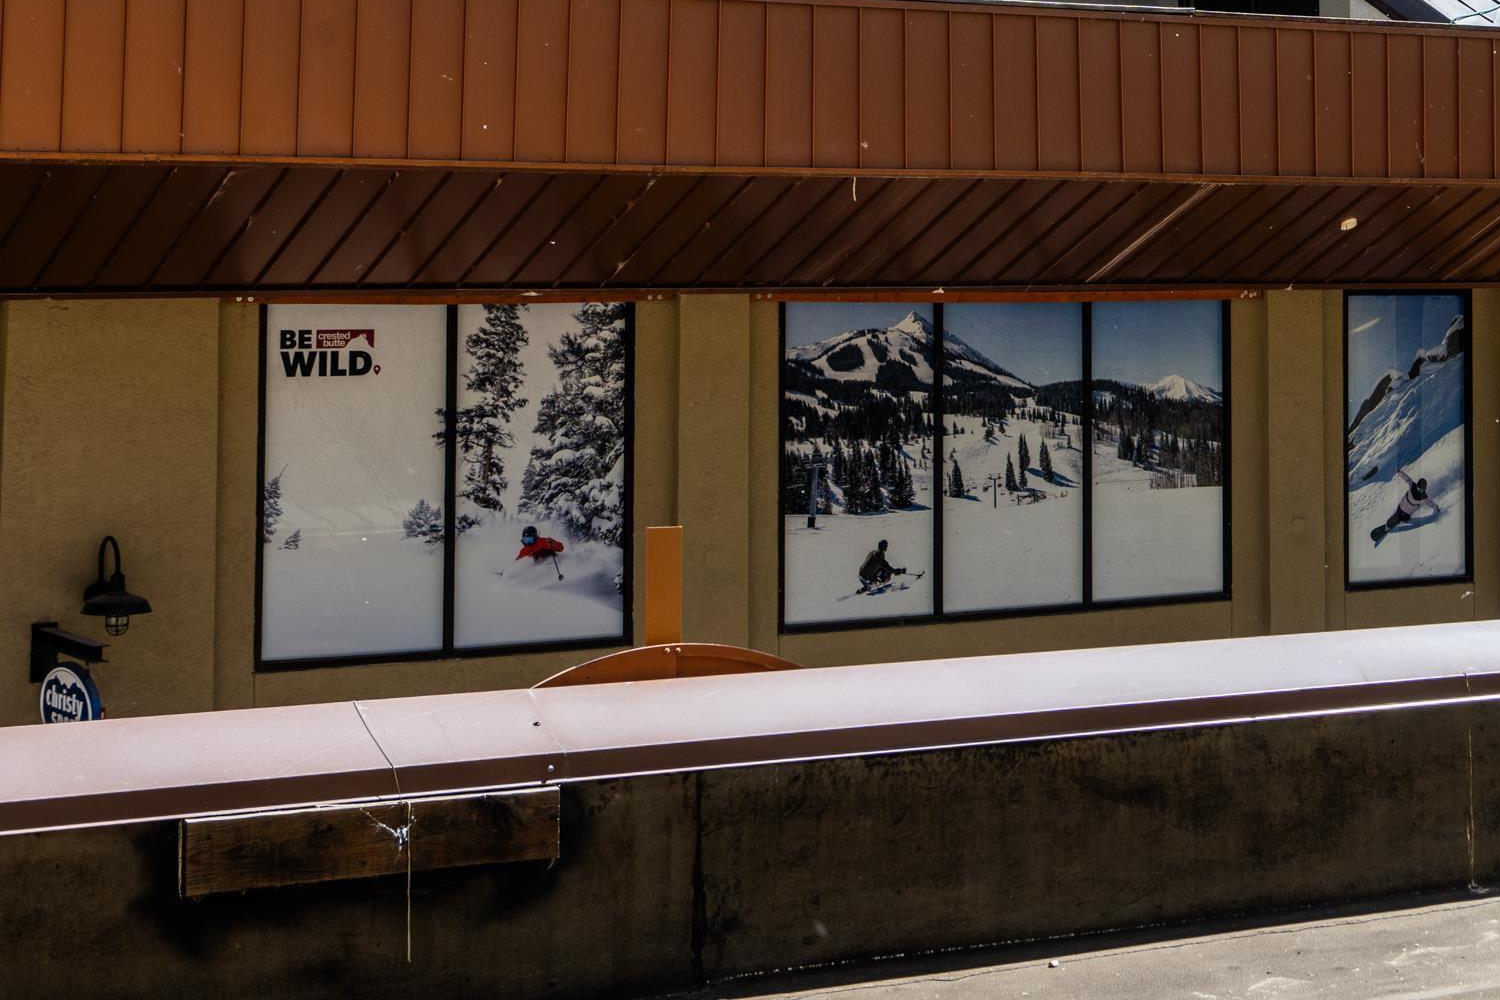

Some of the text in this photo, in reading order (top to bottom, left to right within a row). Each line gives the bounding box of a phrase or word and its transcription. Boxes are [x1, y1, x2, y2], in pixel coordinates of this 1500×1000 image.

[280, 329, 312, 349] BE
[318, 331, 351, 340] crested
[46, 684, 83, 721] christy
